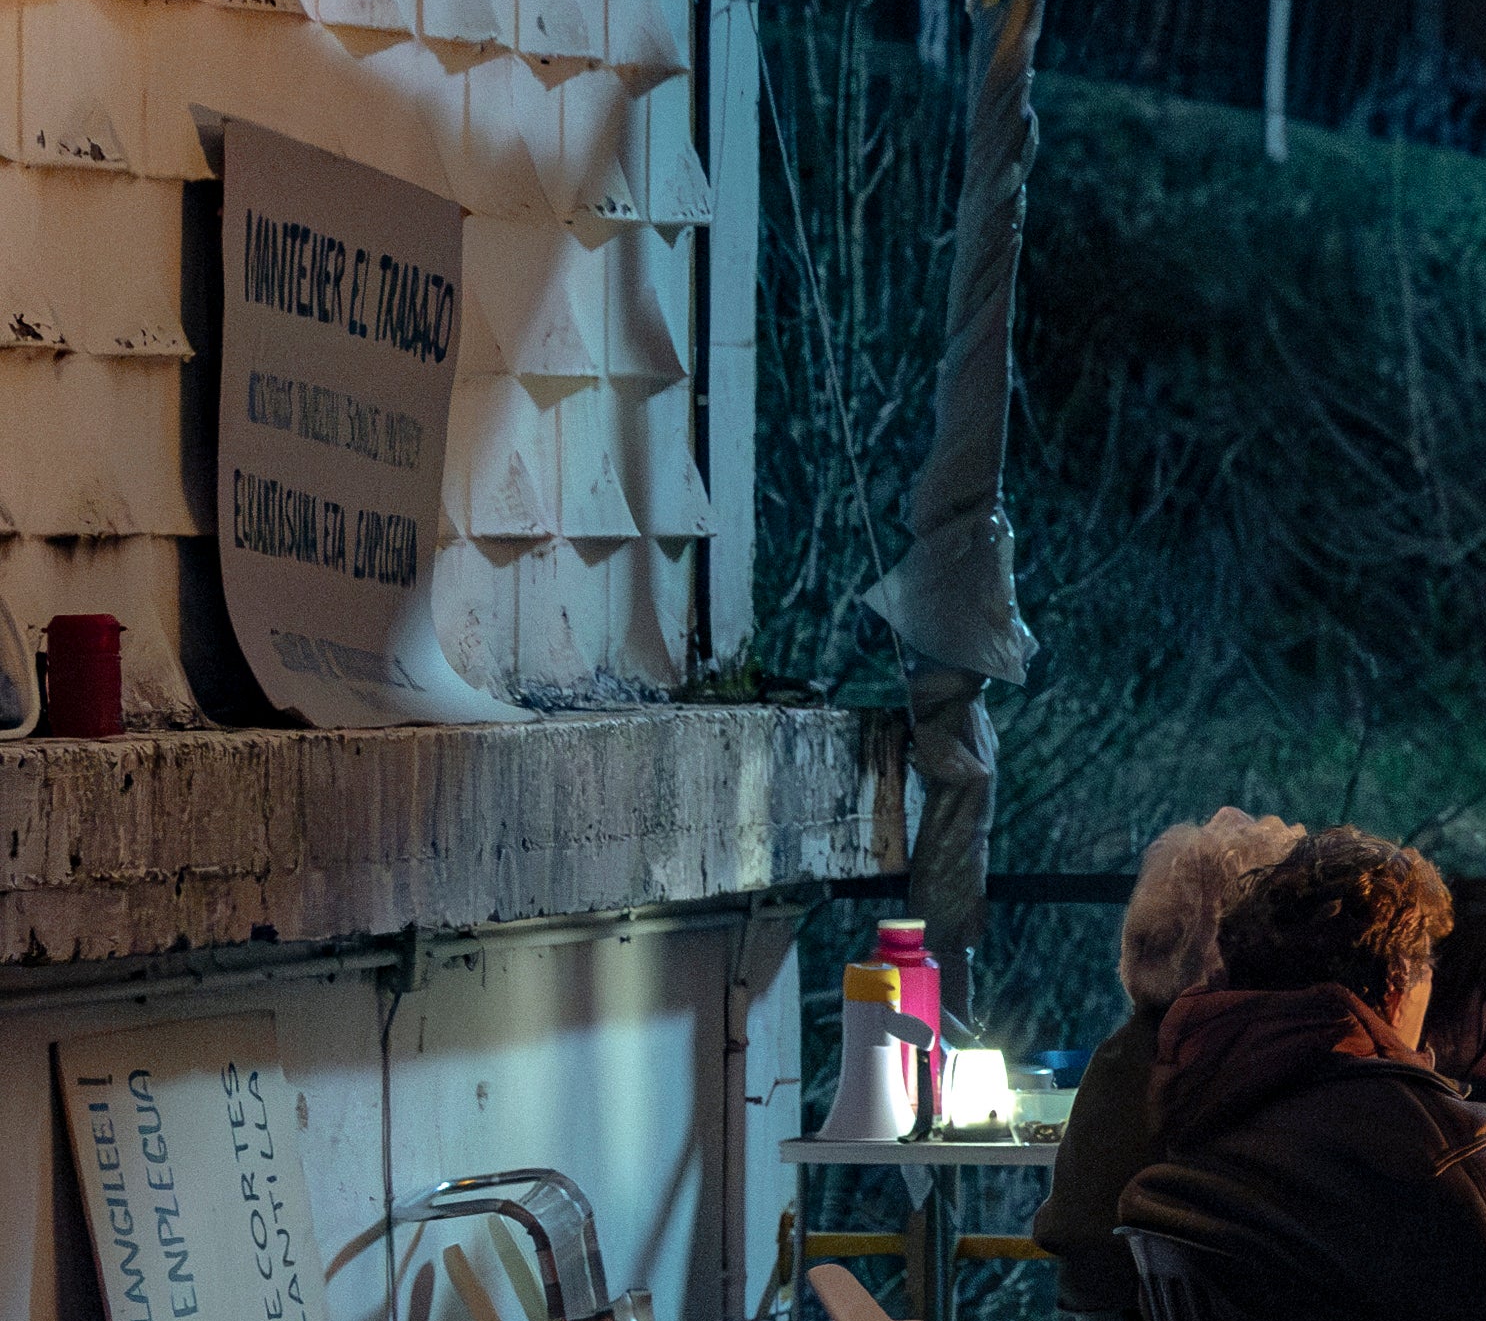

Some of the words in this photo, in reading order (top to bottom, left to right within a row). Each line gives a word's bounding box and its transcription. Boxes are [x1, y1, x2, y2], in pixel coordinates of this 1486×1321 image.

[244, 208, 345, 326] MANTENER
[348, 248, 371, 339] EL
[128, 1068, 199, 1318] ENPLEGUA
